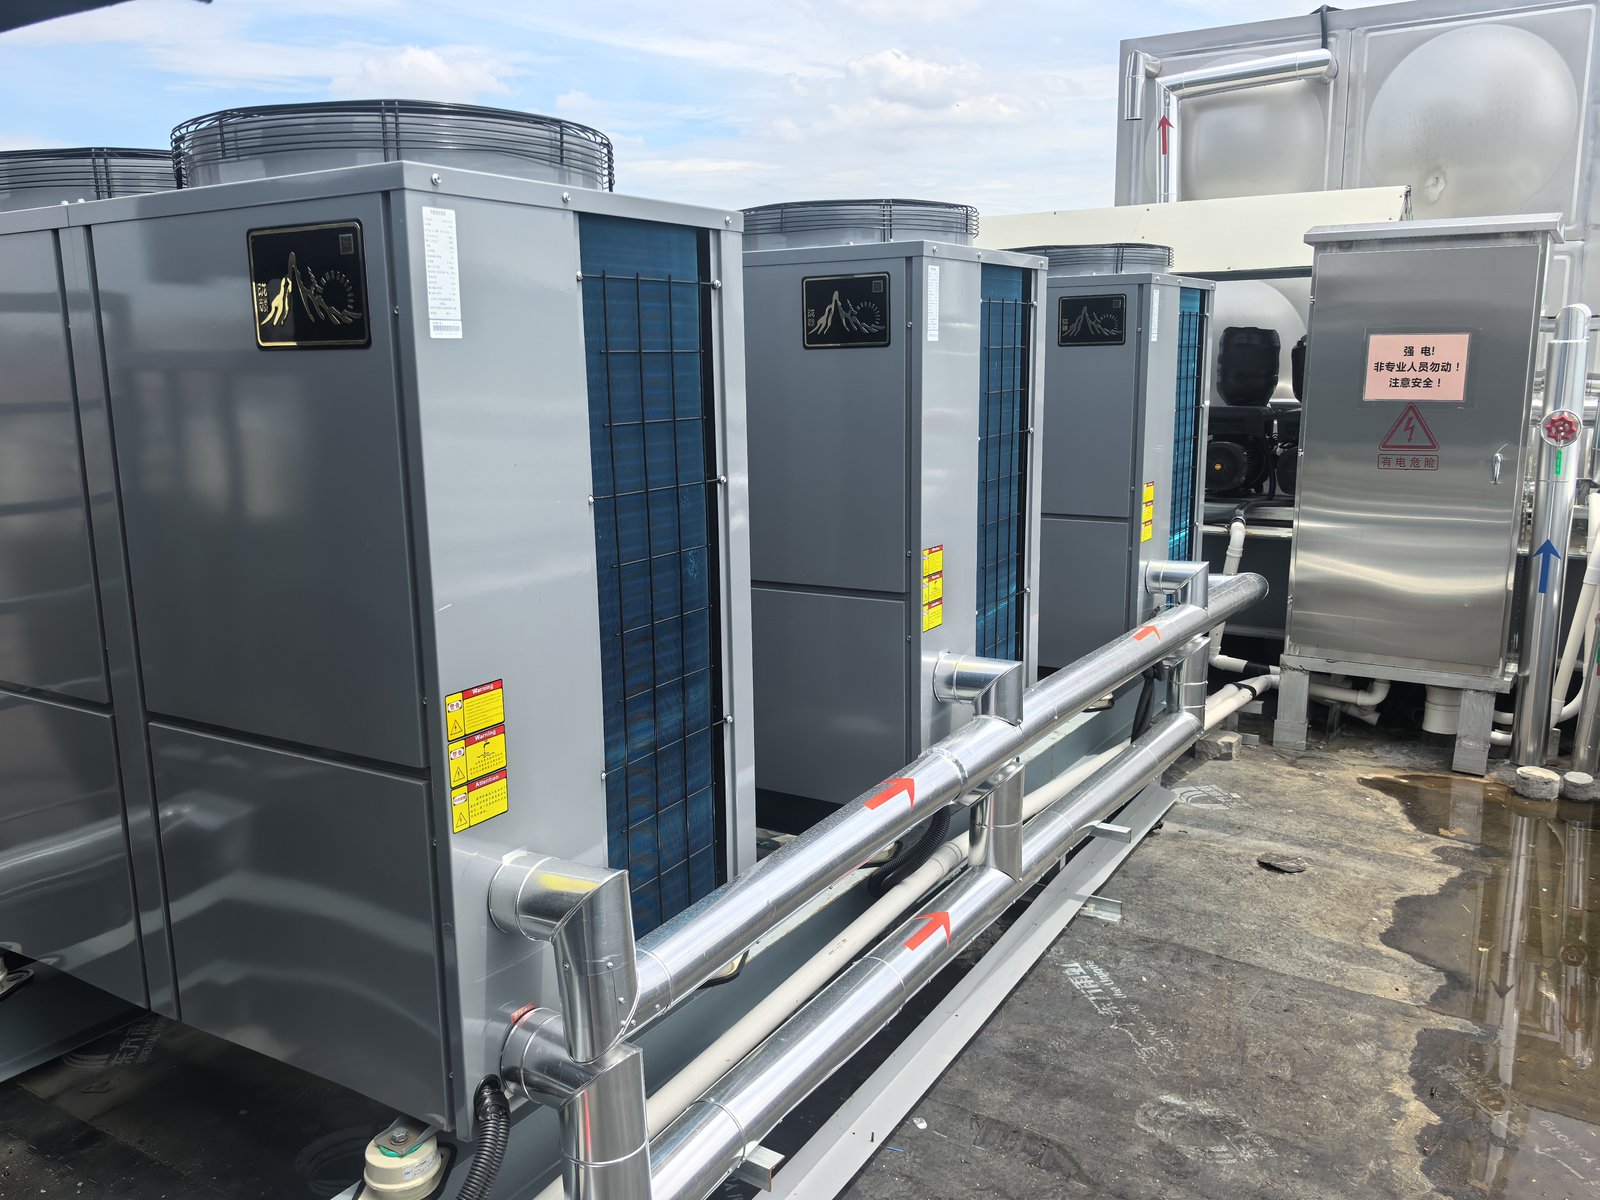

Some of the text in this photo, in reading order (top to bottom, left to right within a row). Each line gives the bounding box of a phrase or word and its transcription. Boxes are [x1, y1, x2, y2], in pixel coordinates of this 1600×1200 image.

[1403, 346, 1415, 357] 强
[1373, 362, 1460, 373] 非专业人员勿动！
[1388, 377, 1441, 388] 注意安全！
[1380, 456, 1436, 468] 有电危险
[472, 684, 494, 695] Warning
[474, 729, 497, 741] Warning
[475, 774, 500, 788] Attention
